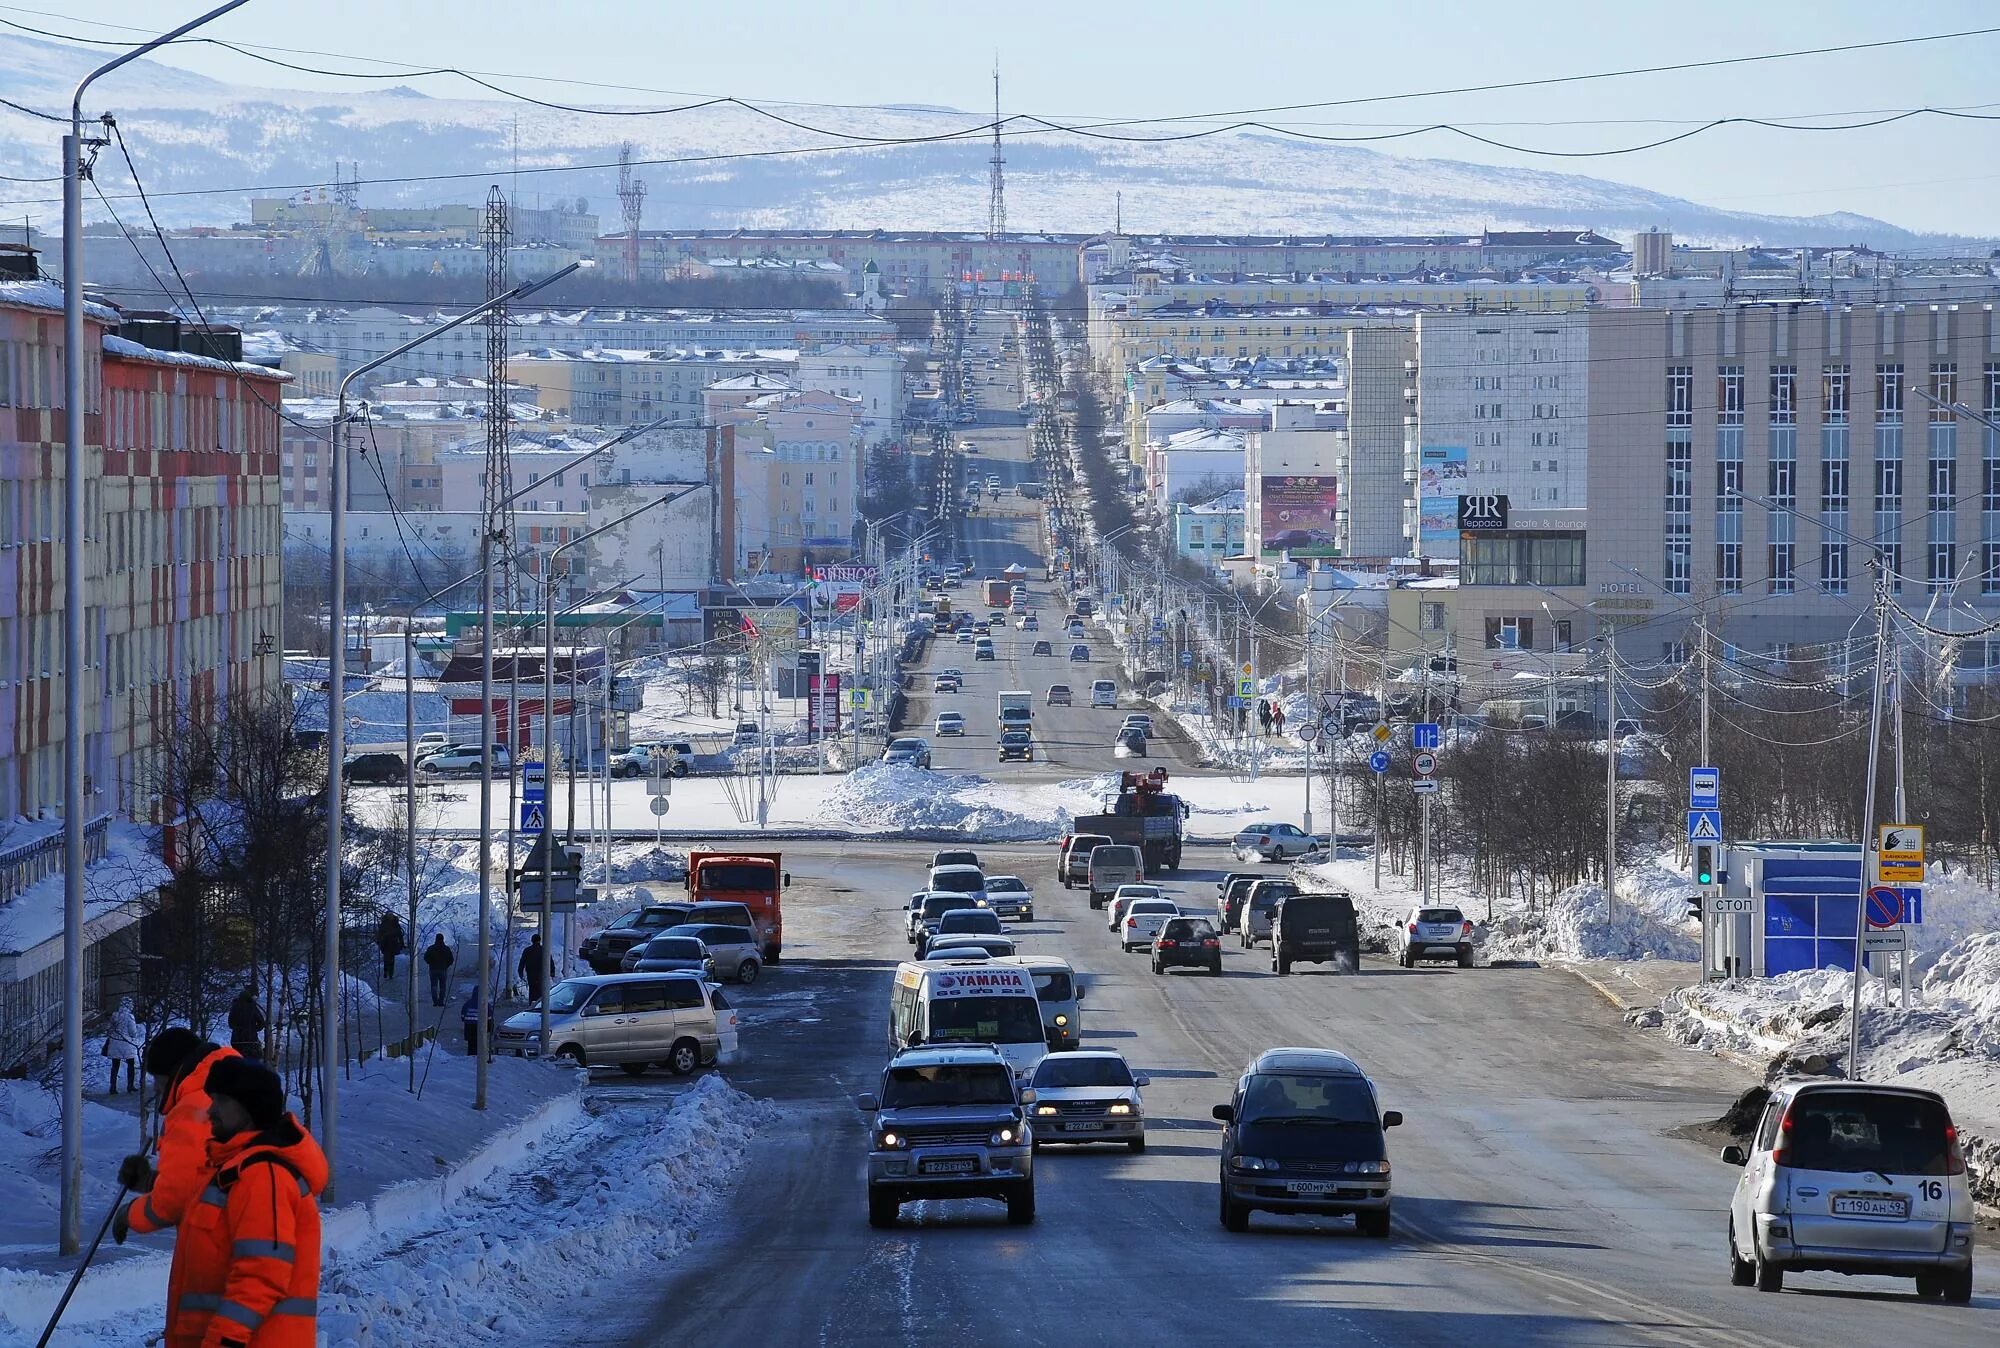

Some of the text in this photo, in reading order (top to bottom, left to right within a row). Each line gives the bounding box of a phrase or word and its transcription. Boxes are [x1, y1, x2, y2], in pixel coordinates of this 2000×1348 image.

[1463, 519, 1502, 528] Терраса
[1515, 520, 1537, 528] cafe
[1543, 520, 1550, 528] &
[1600, 583, 1643, 593] HOTEL
[712, 610, 732, 618] HOTEL
[1716, 899, 1752, 911] СТОП
[956, 975, 1022, 986] YAMAHA
[1918, 1180, 1942, 1201] 16
